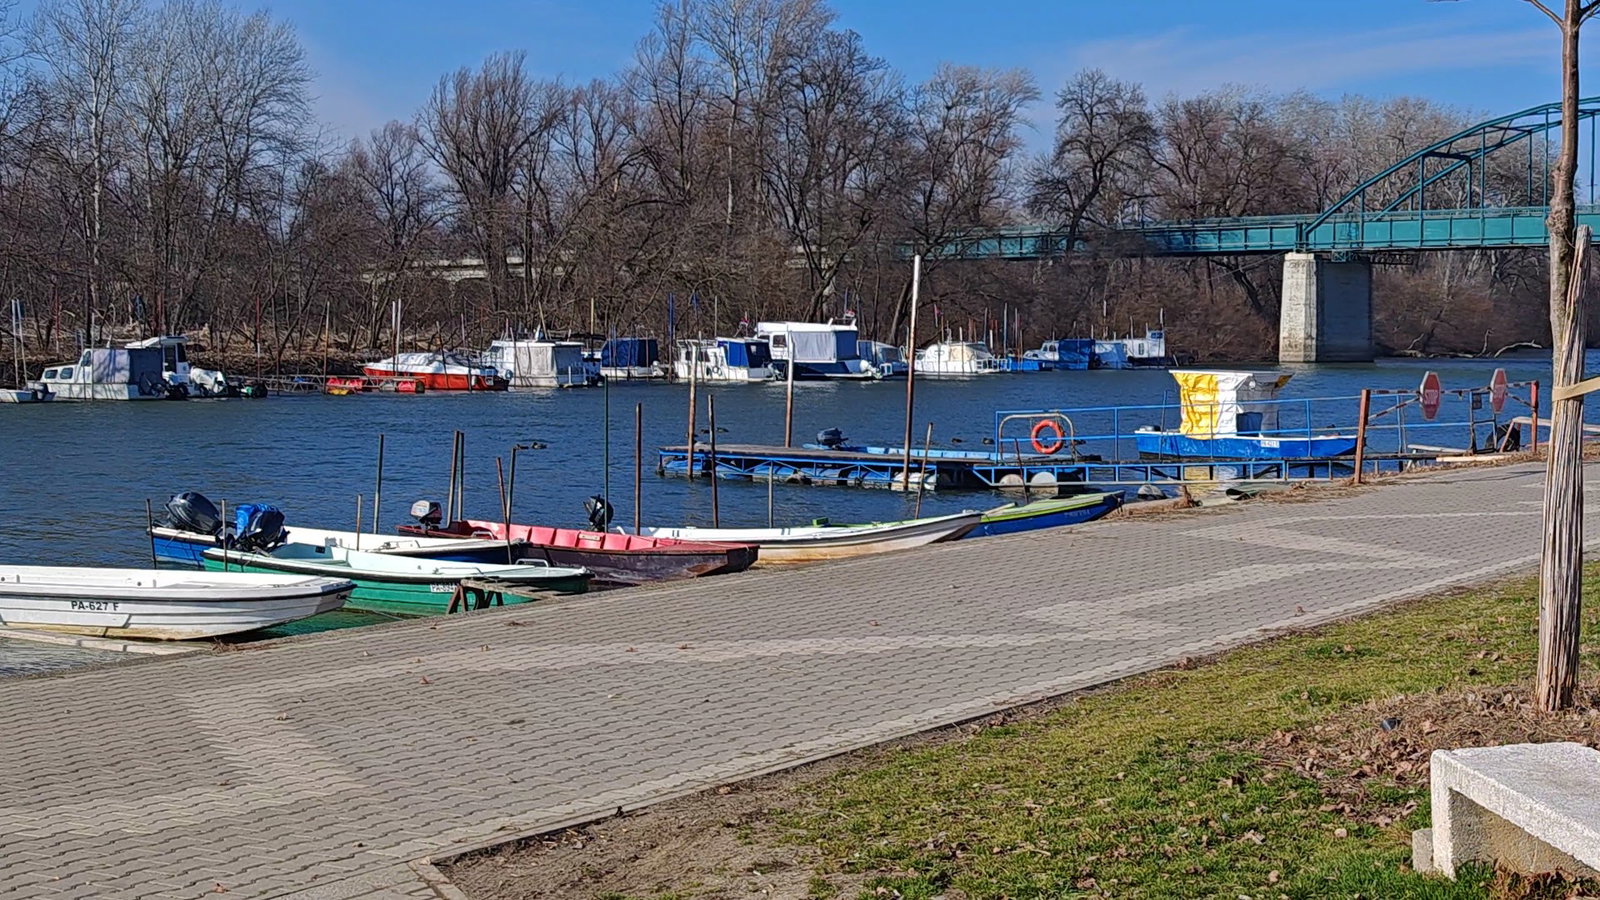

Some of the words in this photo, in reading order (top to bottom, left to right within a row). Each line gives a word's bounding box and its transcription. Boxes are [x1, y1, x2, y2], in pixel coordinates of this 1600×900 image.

[1424, 389, 1439, 405] STOP
[71, 600, 109, 611] PA-627
[113, 602, 120, 611] F
